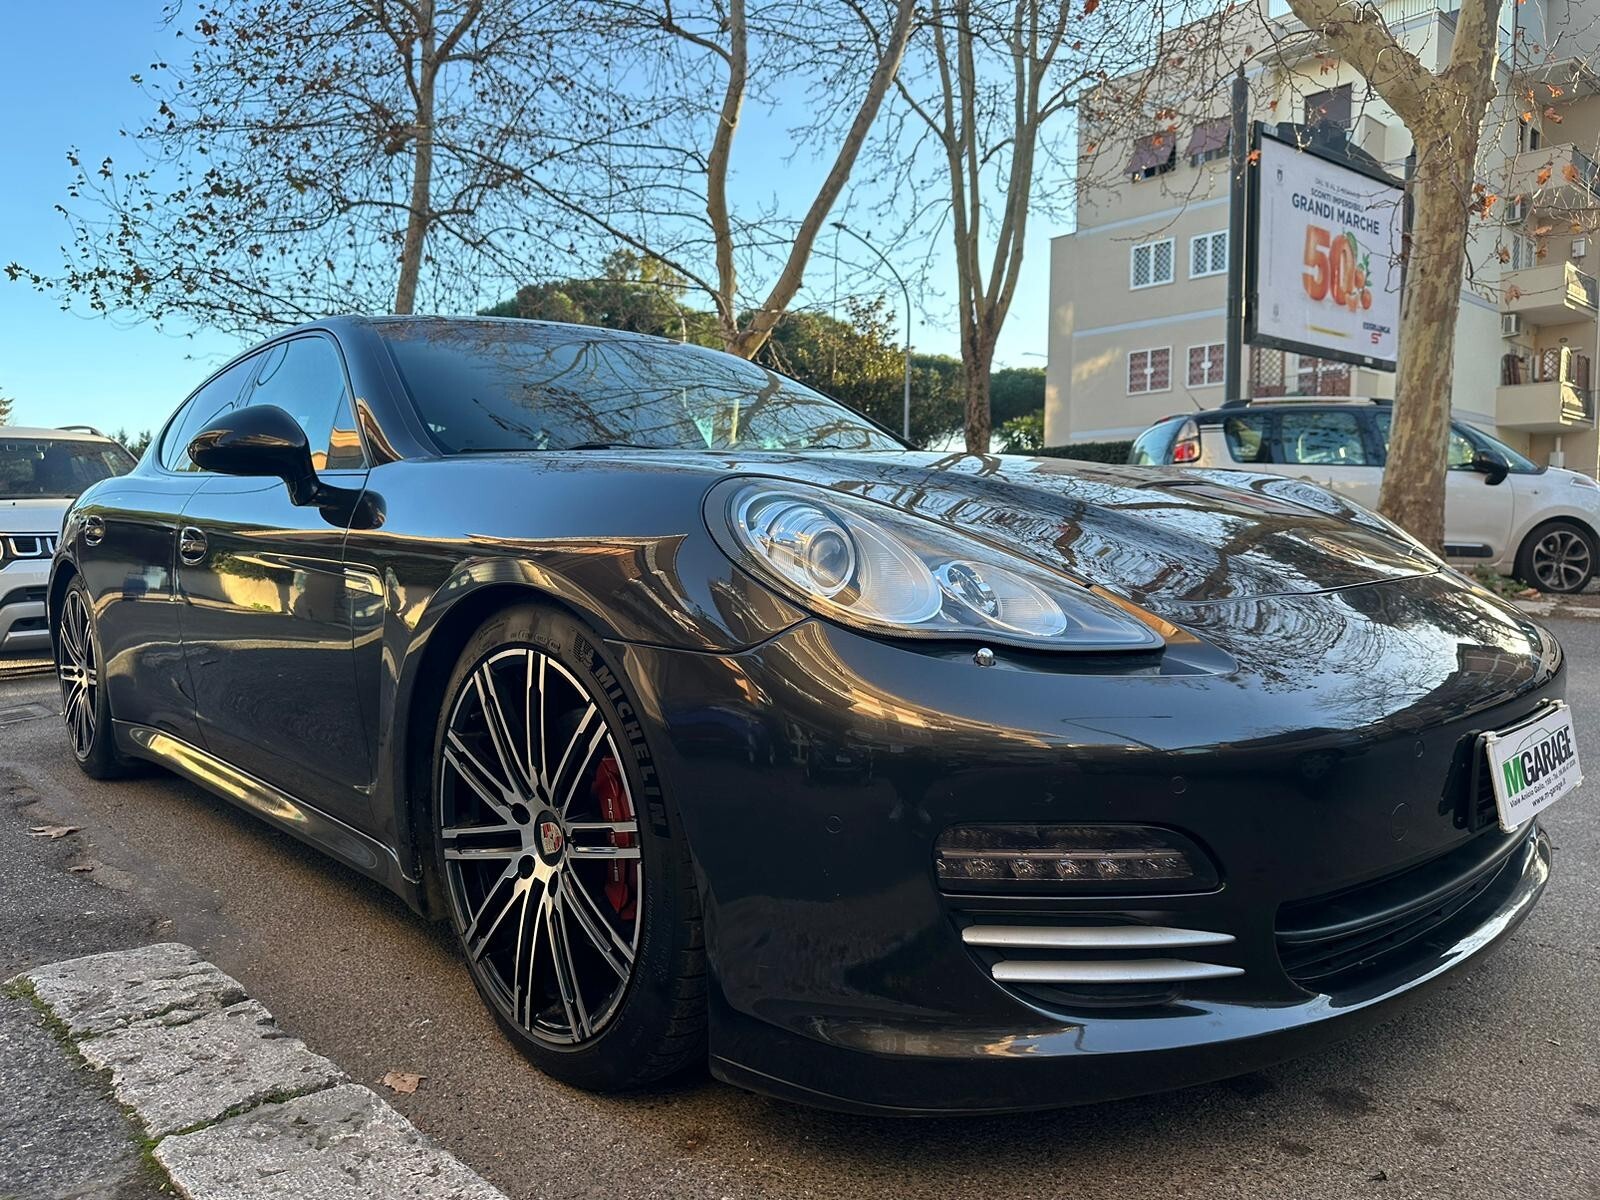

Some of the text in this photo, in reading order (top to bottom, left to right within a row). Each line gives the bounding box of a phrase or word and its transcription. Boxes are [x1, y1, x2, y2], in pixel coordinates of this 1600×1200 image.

[1292, 192, 1335, 221] GRANDI
[1337, 208, 1380, 235] MARCHE
[1311, 187, 1332, 202] SCONTI
[595, 664, 667, 828] MICHELIN
